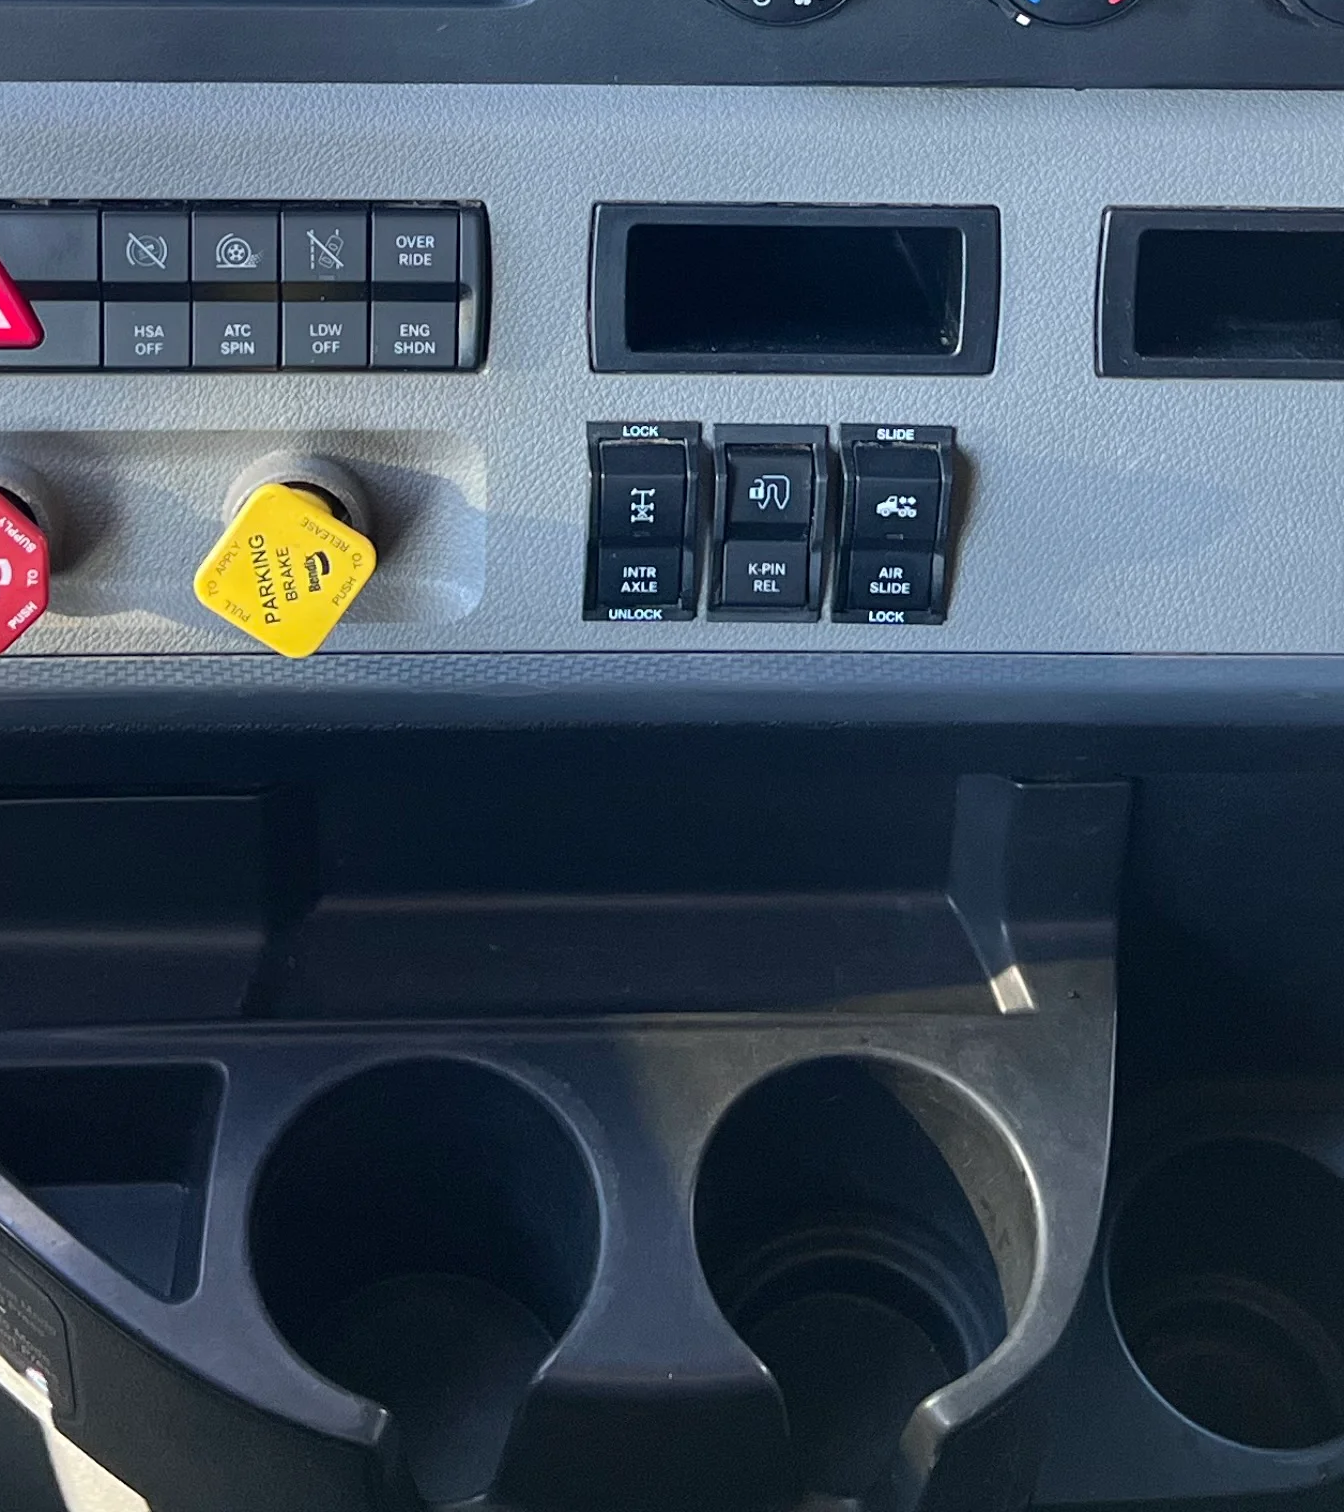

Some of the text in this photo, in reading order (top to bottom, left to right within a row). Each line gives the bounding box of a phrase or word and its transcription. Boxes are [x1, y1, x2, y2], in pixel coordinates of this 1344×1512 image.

[395, 235, 435, 250] OVER
[398, 253, 433, 267] RIDE
[134, 324, 164, 339] HSA
[223, 324, 252, 338] ATC
[309, 323, 343, 338] LDW
[399, 324, 430, 338] ENG
[135, 341, 164, 356] OFF
[220, 341, 255, 356] SPIN
[312, 340, 340, 354] OFF
[393, 341, 436, 355] SHDN
[622, 426, 659, 438] LOCK
[876, 429, 914, 441] SLIDE
[300, 516, 363, 608] PUSH TO RELEASE
[276, 546, 298, 602] BRAKE
[623, 566, 657, 579] INTR
[748, 563, 786, 576] K-PIN
[879, 567, 903, 580] AIR
[207, 540, 252, 623] PULL TO APPLY
[248, 534, 281, 625] PARKING
[753, 580, 780, 592] REL
[620, 581, 658, 594] AXLE
[870, 582, 910, 594] SLIDE
[7, 601, 38, 630] PUSH
[26, 569, 39, 588] TO
[608, 608, 662, 620] UNLOCK
[868, 610, 904, 623] LOCK
